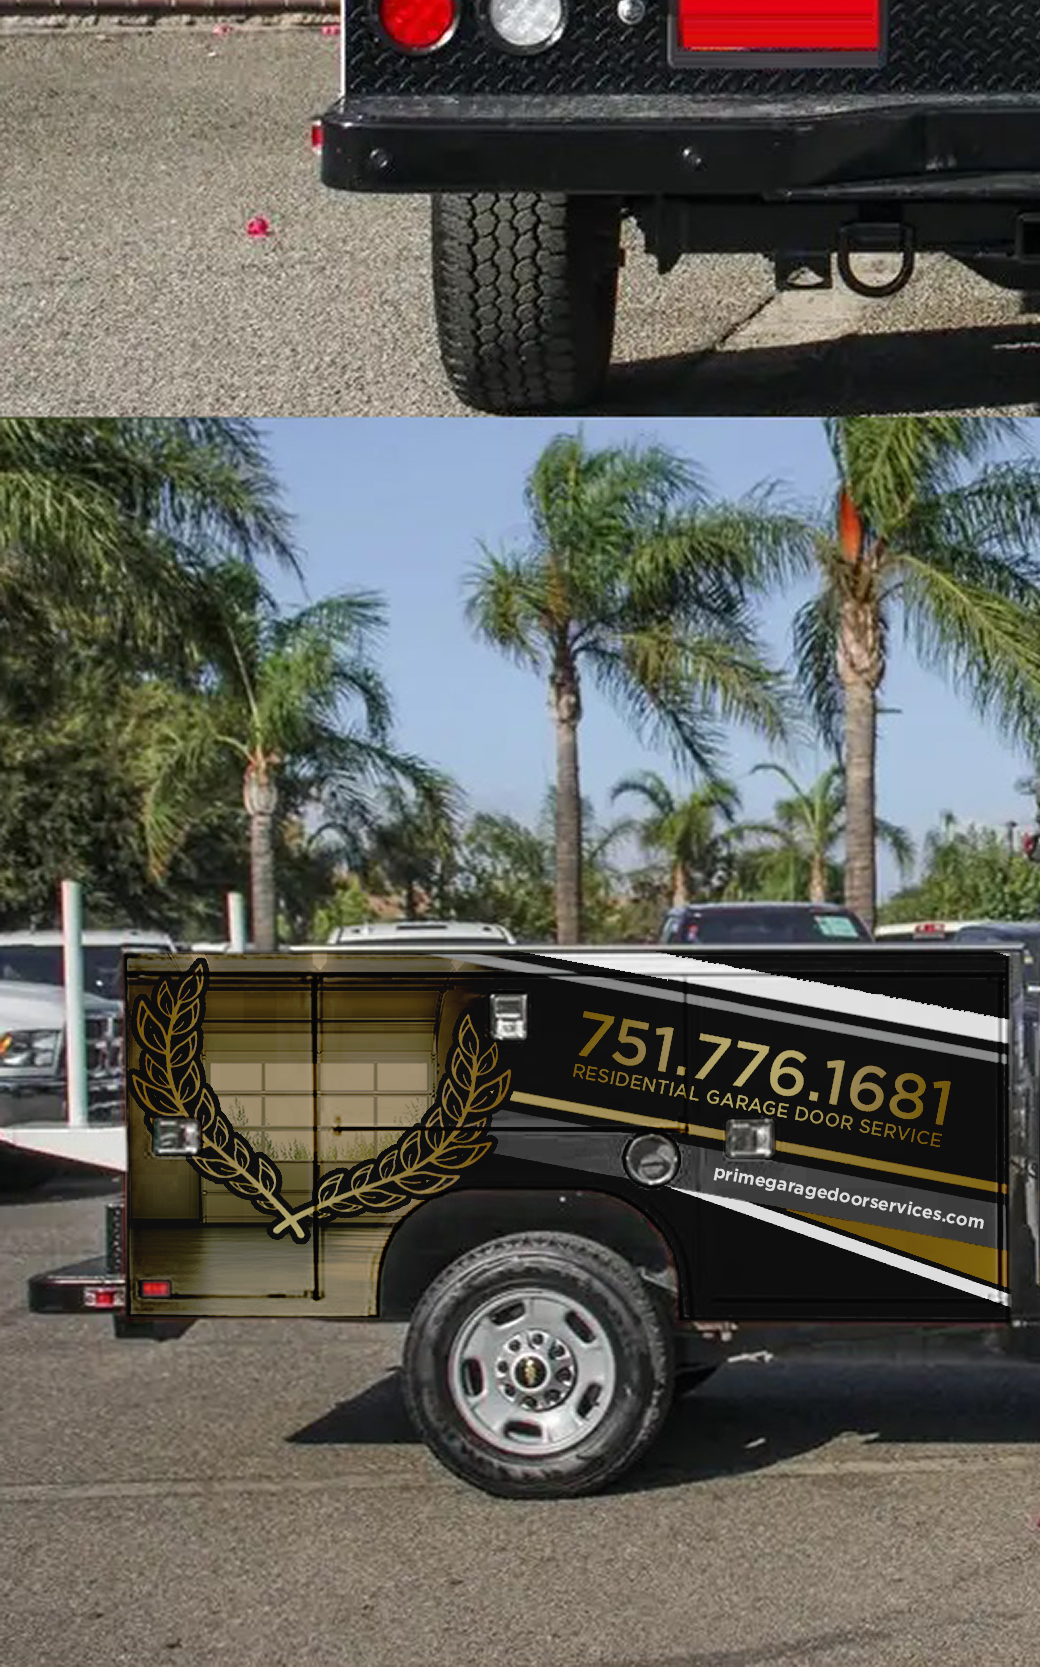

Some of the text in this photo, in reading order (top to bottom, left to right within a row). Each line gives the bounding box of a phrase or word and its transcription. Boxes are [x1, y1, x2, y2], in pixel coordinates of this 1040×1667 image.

[573, 1064, 943, 1148] RESIDENTIAL GARAGE DOOR SERVICE
[577, 1011, 952, 1126] 751.776.1681
[713, 1167, 985, 1230] primegaragedoorservices.com
